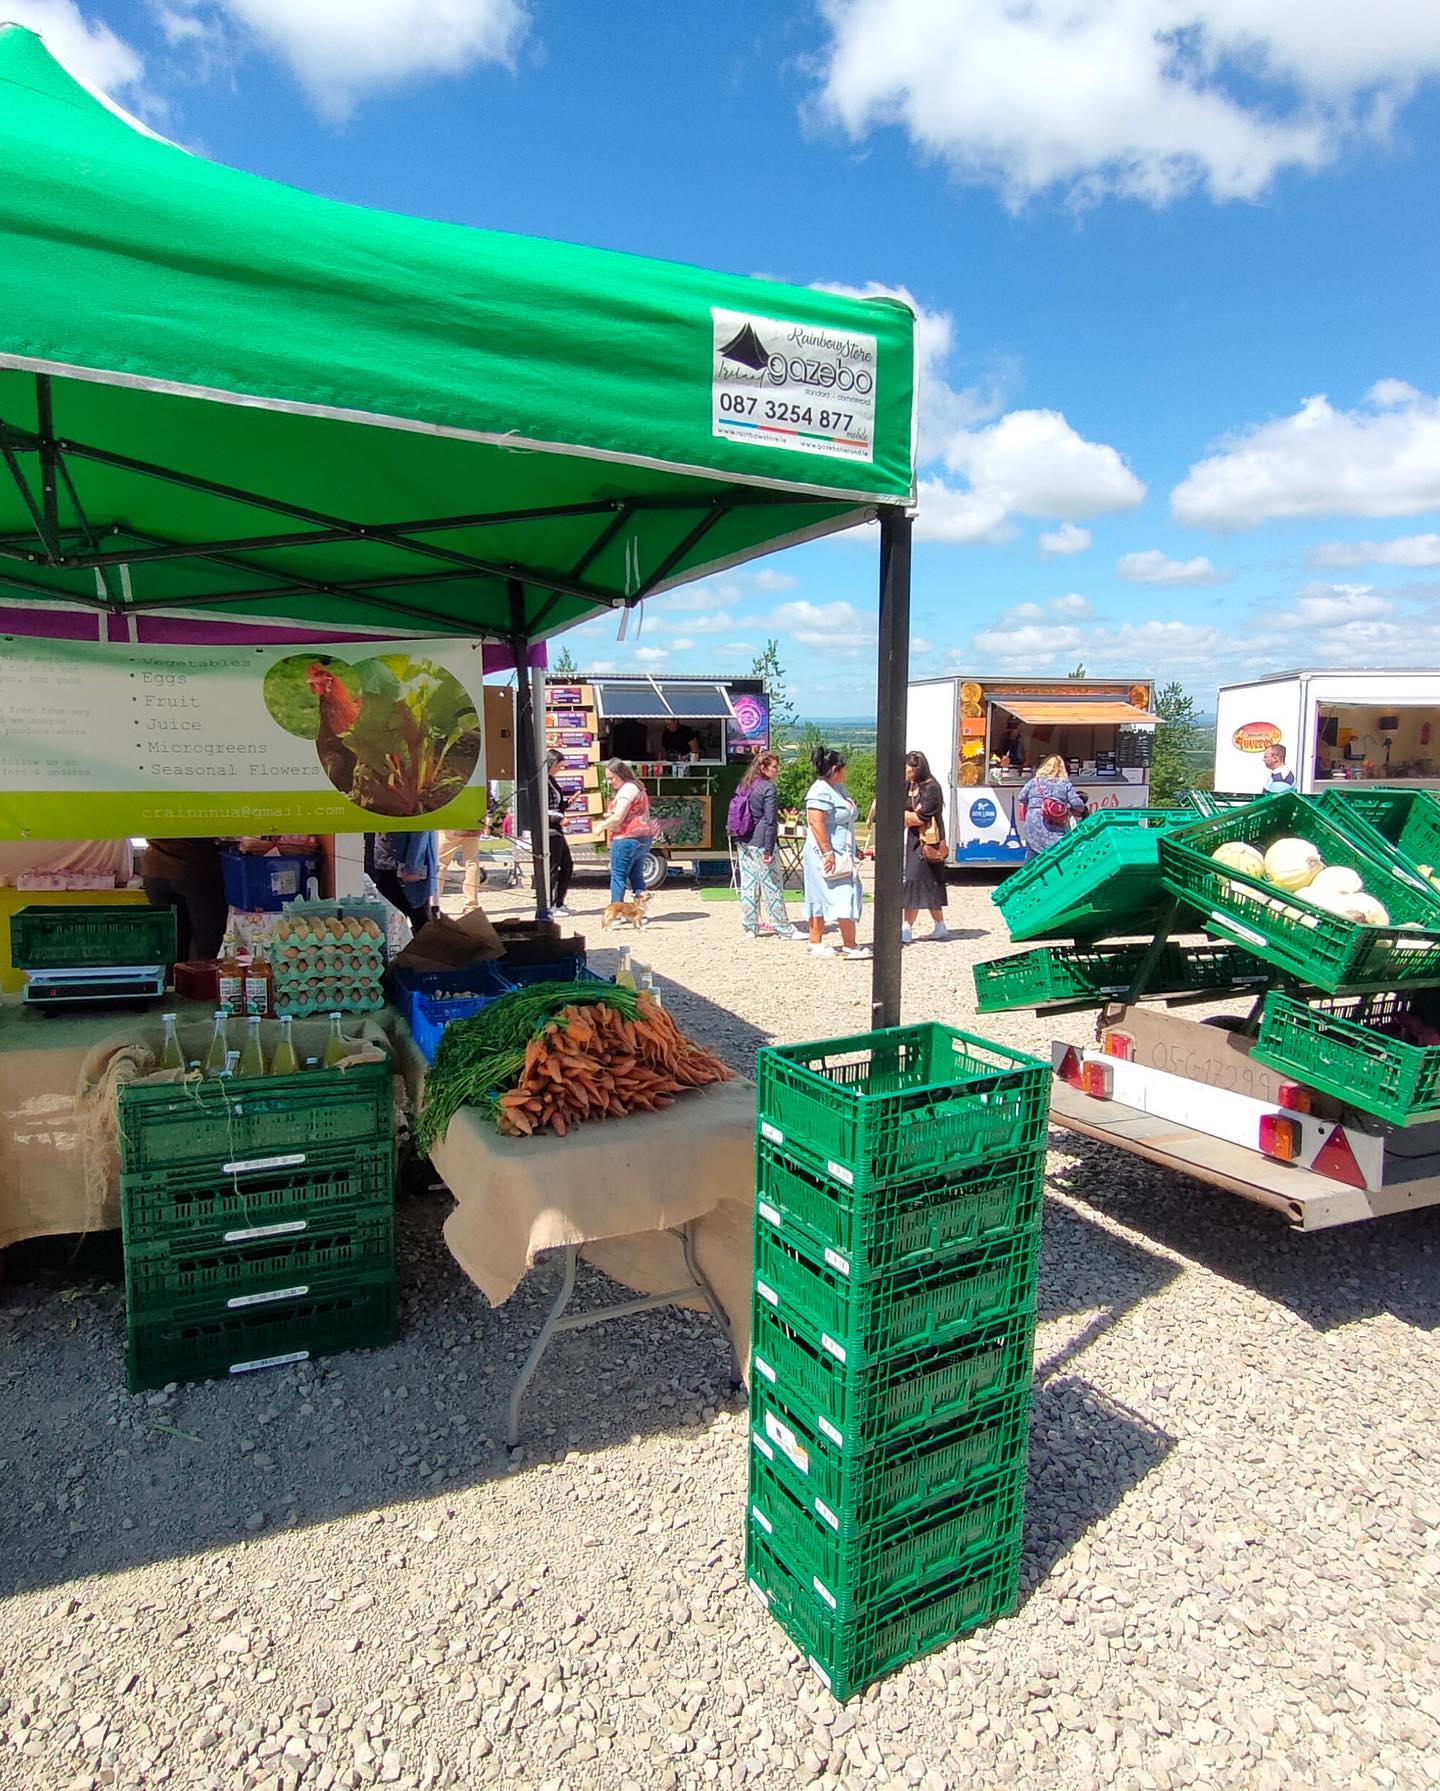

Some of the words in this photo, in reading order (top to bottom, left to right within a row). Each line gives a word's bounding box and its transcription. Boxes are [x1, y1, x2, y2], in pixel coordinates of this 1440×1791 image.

[767, 352, 873, 395] gazebo
[720, 393, 758, 416] 087
[764, 400, 813, 425] 3254
[819, 410, 854, 432] 877
[141, 656, 252, 669] Vegetables
[143, 671, 187, 687] Eggs
[144, 695, 201, 708] Fruit
[146, 718, 203, 731] Juice
[148, 740, 269, 756] Microgreens
[151, 763, 237, 776] Seasonal
[249, 764, 321, 776] Flowers
